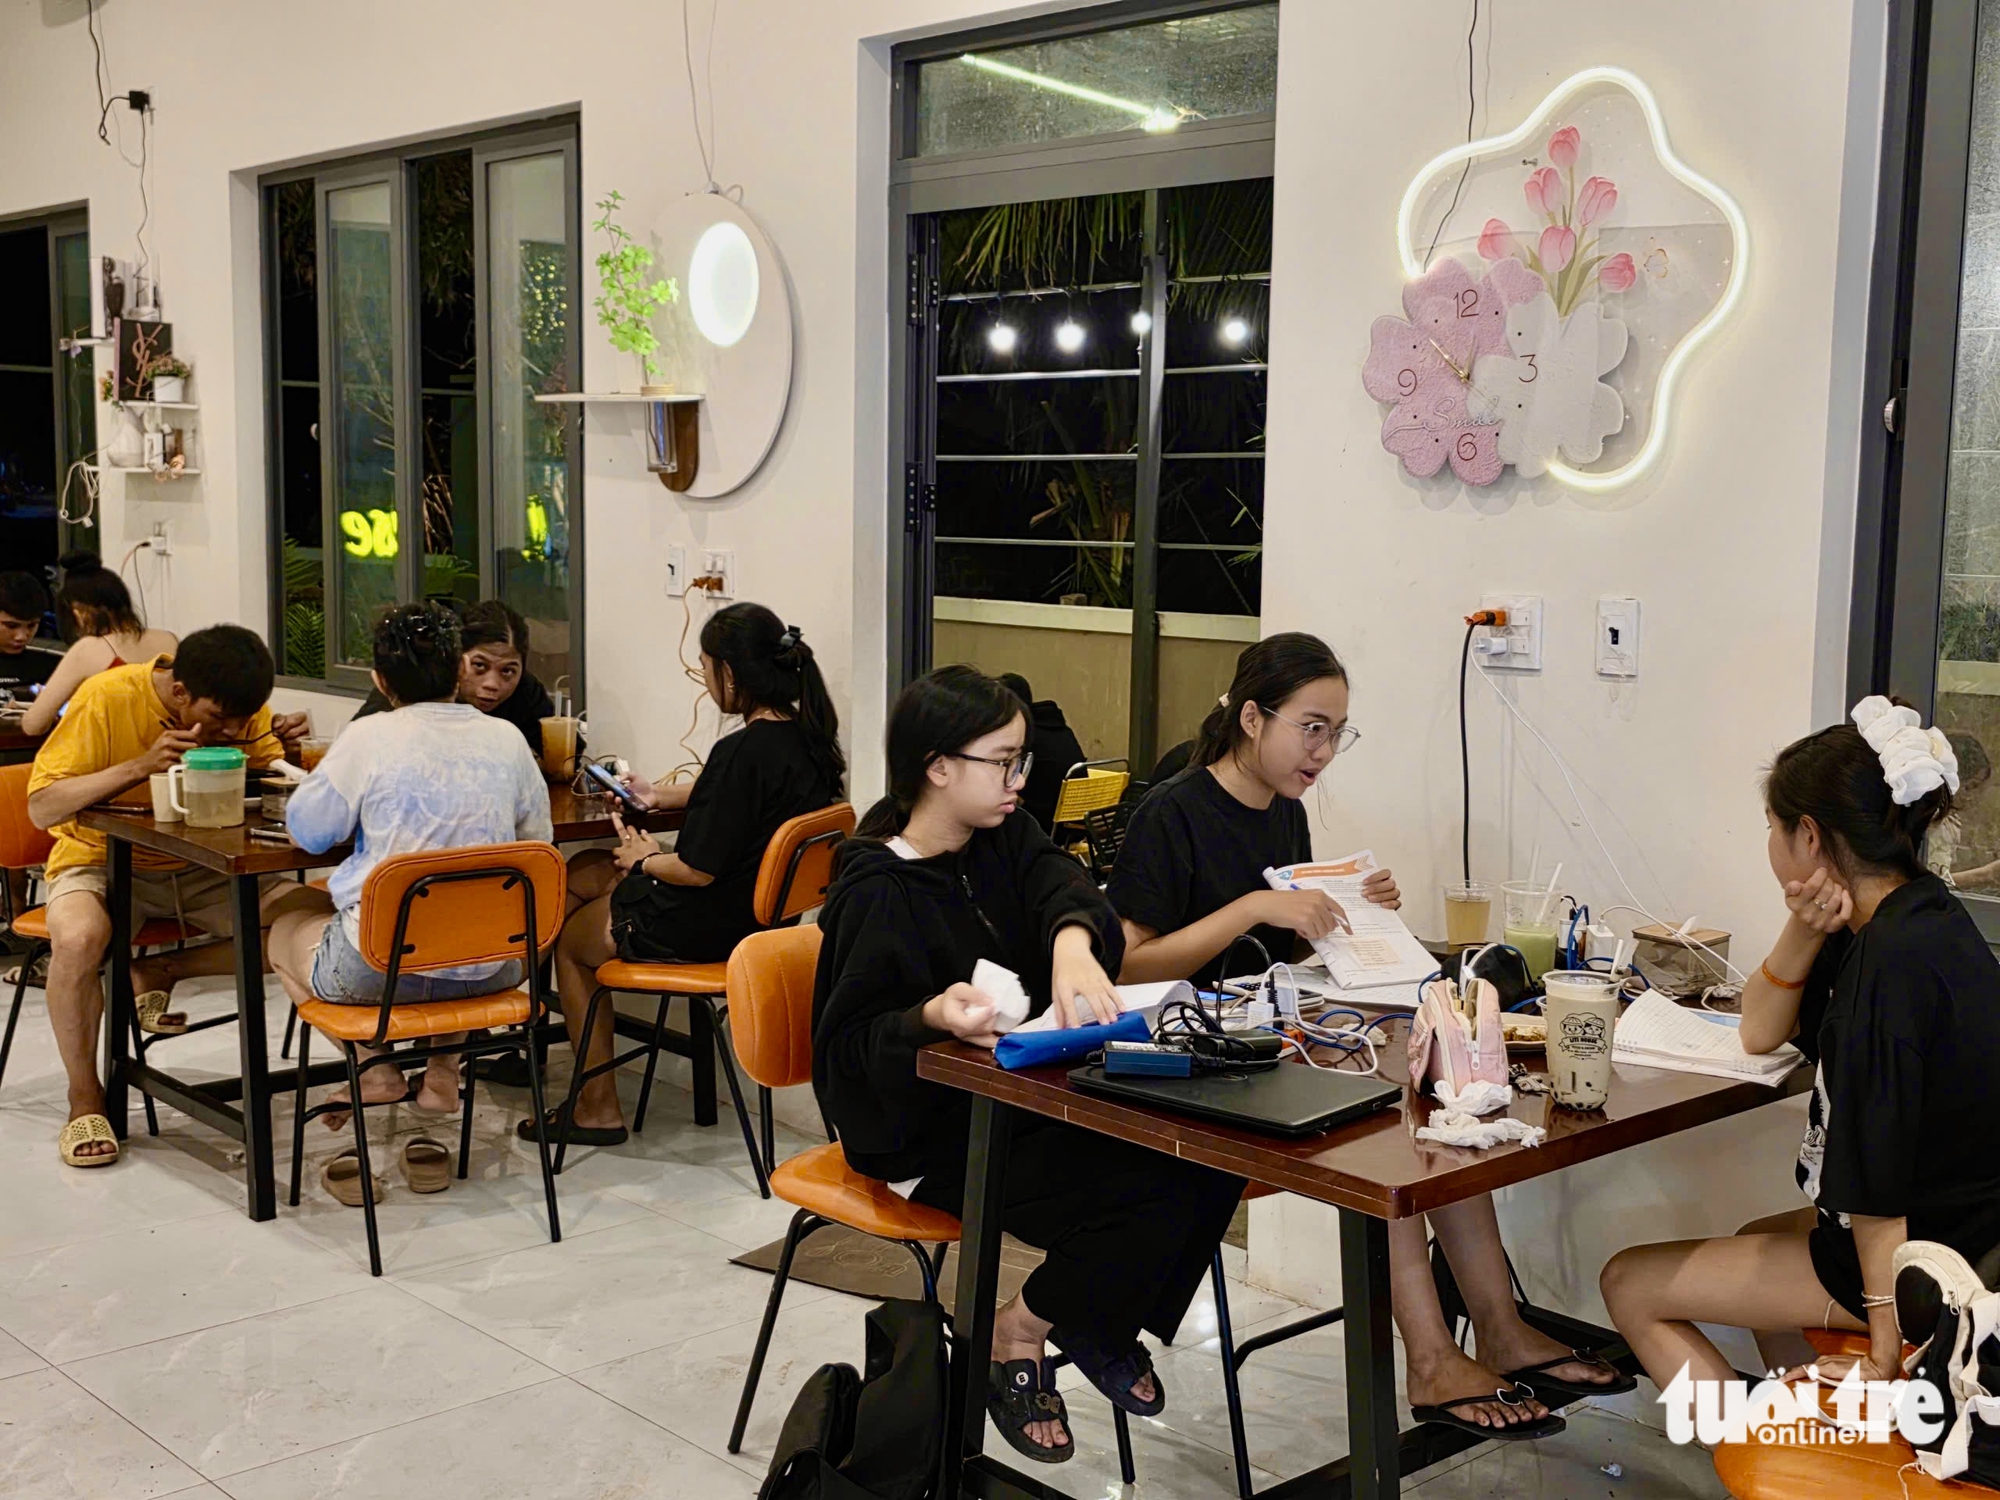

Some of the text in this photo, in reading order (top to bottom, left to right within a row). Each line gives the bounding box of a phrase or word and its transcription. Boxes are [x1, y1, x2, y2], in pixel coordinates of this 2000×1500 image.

[1453, 288, 1479, 319] 12
[1397, 368, 1418, 396] 9
[1518, 353, 1538, 383] 3
[1456, 432, 1477, 461] 6
